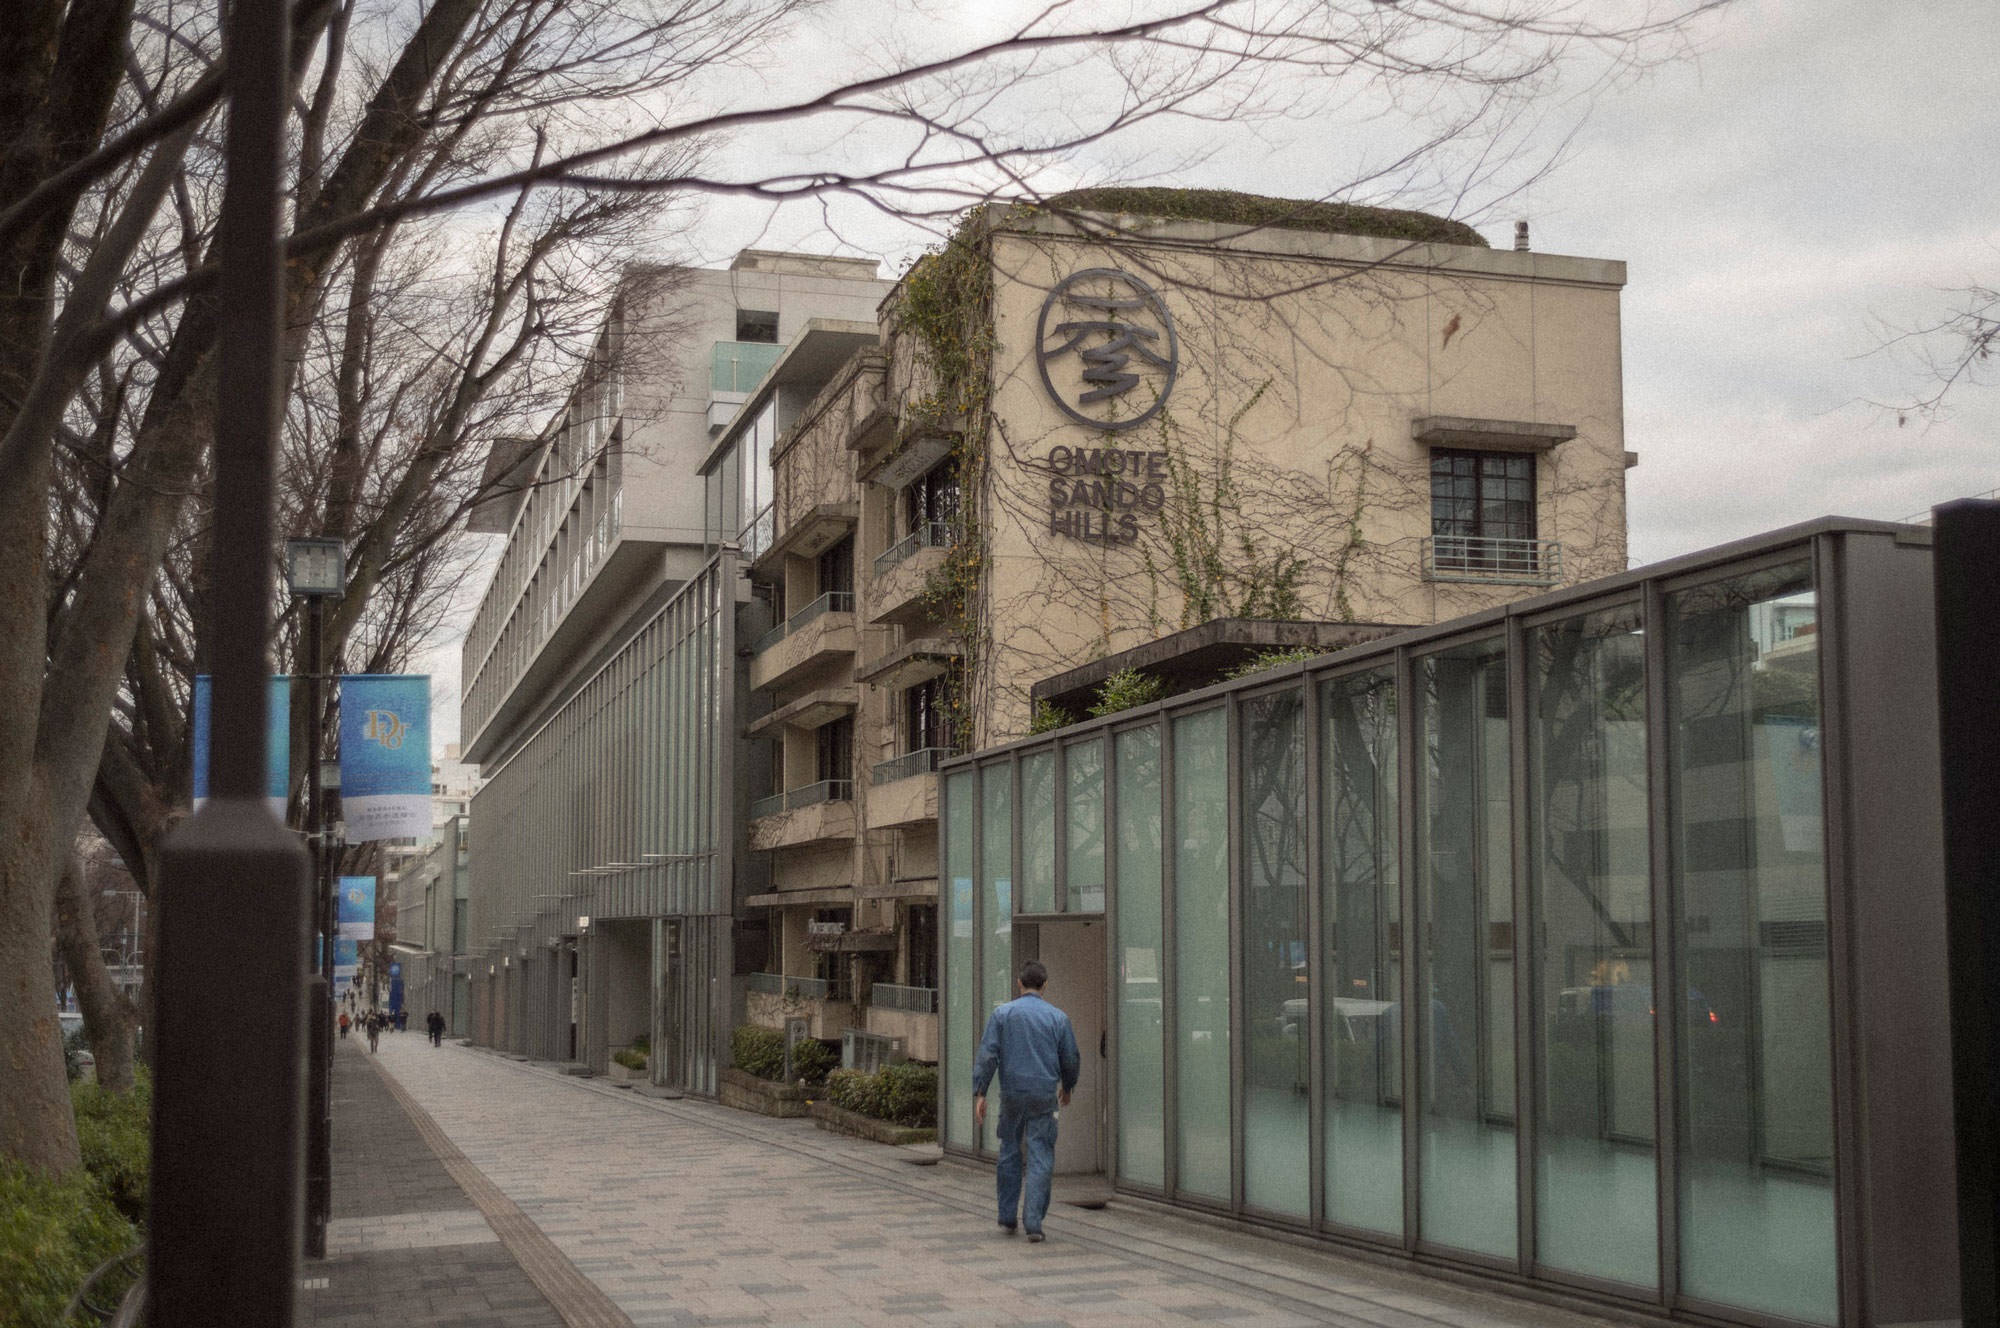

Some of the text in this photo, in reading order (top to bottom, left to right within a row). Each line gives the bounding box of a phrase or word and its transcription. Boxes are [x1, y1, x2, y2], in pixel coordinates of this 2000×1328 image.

[1049, 446, 1168, 479] OMOTE
[1049, 478, 1165, 511] SANDO
[1050, 510, 1139, 542] HILLS
